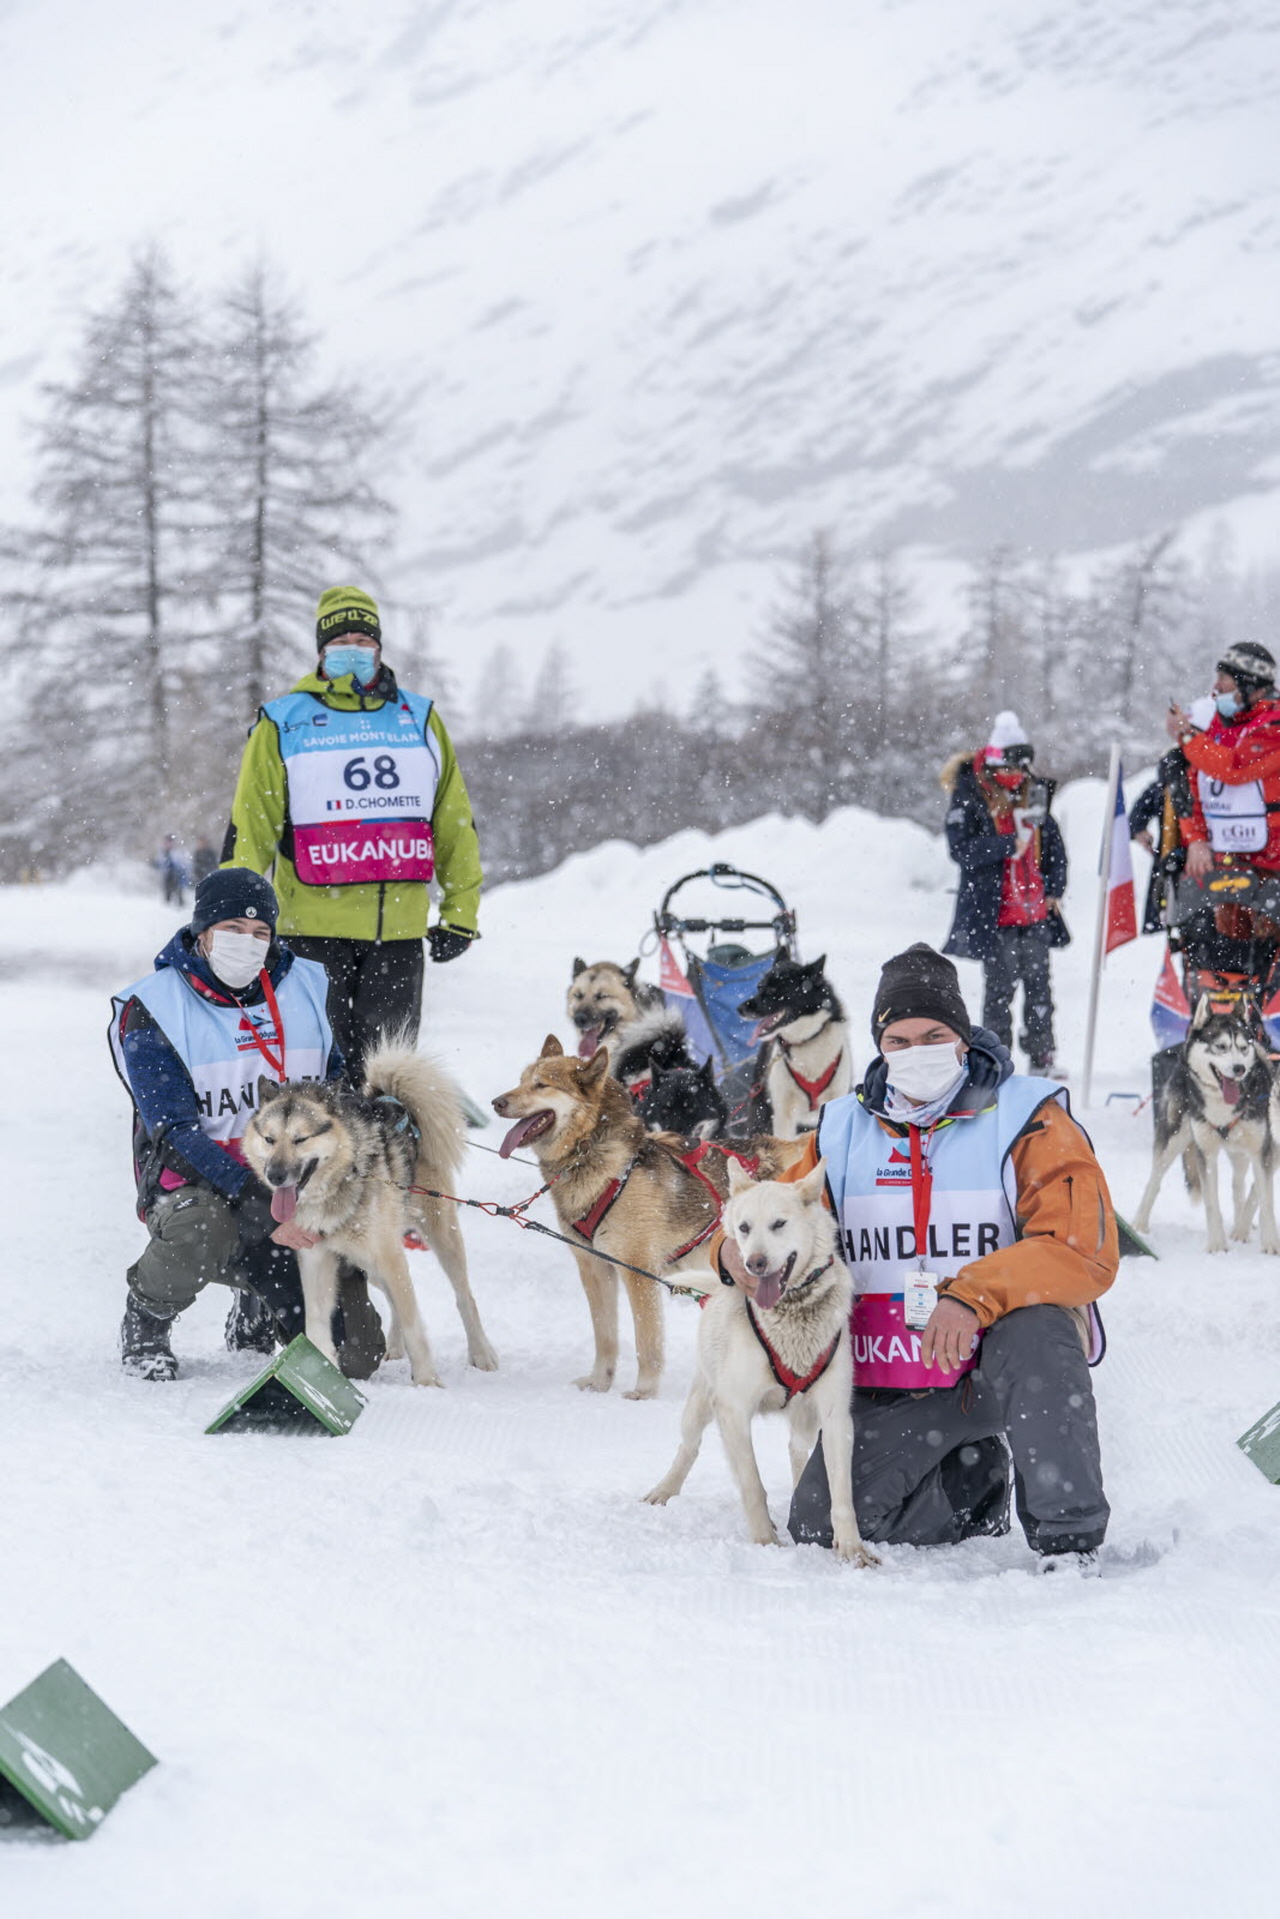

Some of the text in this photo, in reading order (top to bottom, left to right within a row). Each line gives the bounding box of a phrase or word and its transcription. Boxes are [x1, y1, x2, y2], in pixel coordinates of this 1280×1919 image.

[304, 735, 347, 747] SAVOIE
[349, 731, 385, 742] MONT
[343, 754, 400, 791] 68
[345, 796, 421, 810] D.CHOMETTE
[876, 1168, 883, 1176] la
[883, 1168, 907, 1177] Grande
[839, 1223, 1000, 1265] HANDLER
